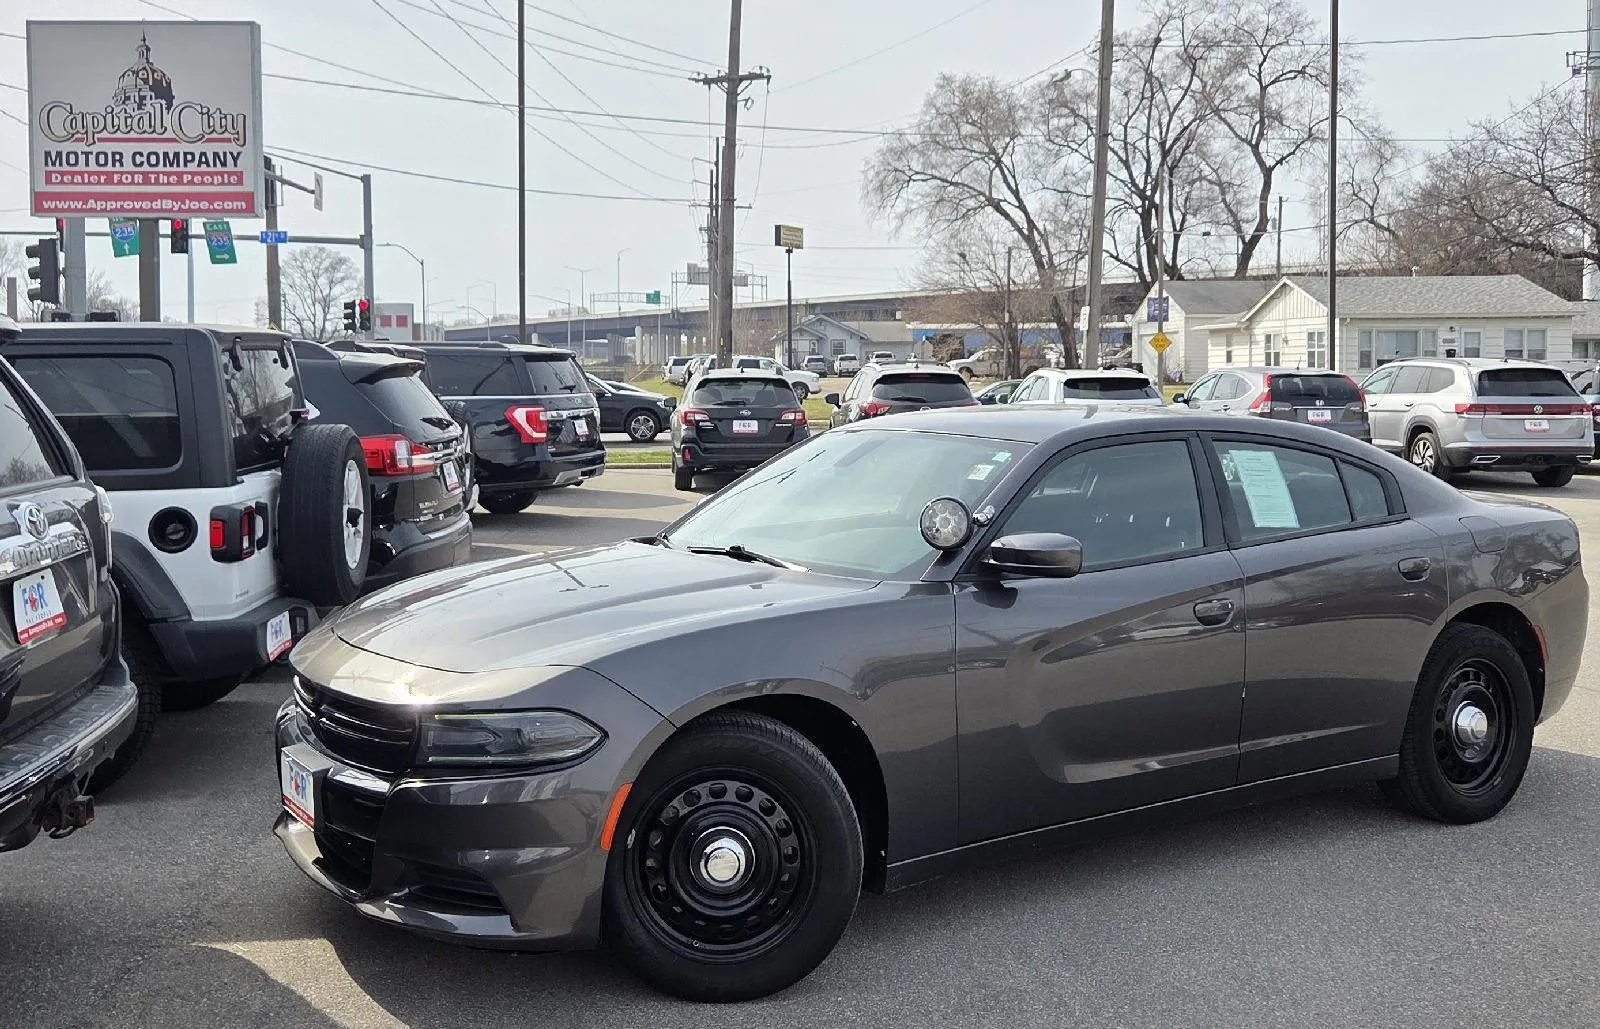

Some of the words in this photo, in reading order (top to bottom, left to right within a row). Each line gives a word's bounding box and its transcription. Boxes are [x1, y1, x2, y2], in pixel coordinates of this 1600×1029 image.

[39, 100, 167, 146] Capital
[170, 101, 247, 147] City
[44, 150, 125, 168] MOTOR
[131, 150, 243, 169] COMPANY
[51, 173, 108, 184] Dealer
[113, 173, 144, 184] FOR
[148, 173, 178, 184] The
[183, 173, 238, 186] People
[42, 198, 247, 212] www.ApprovedByJoe.com
[116, 227, 134, 237] 235
[211, 236, 230, 246] 235
